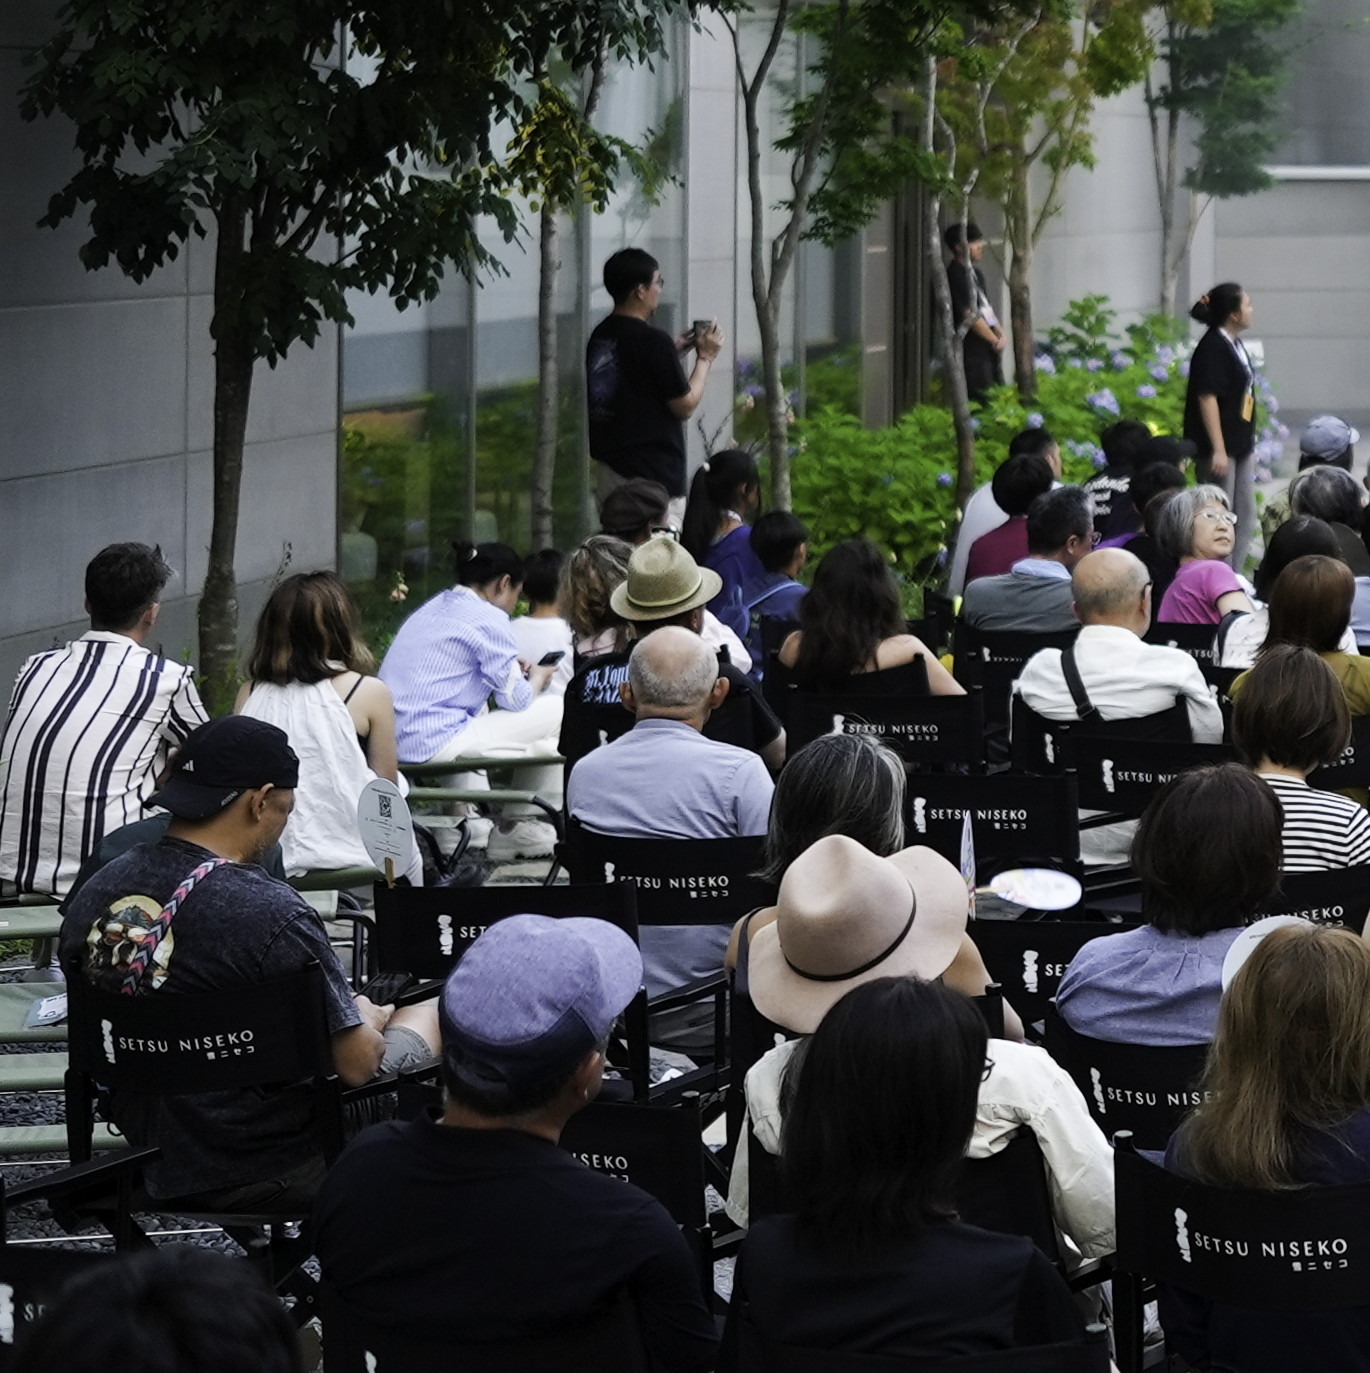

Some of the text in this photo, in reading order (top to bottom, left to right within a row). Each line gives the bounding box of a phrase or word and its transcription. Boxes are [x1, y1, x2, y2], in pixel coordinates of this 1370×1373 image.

[1187, 648, 1213, 659] TSU
[892, 723, 939, 735] NISEKO
[1117, 770, 1153, 784] SETSU
[930, 808, 1027, 821] SETSU NISEKO
[620, 875, 730, 890] TSU NISEKO
[459, 925, 487, 939] SET
[118, 1029, 255, 1054] SETSU NISEKO
[1107, 1086, 1221, 1107] SETSU NISE
[572, 1152, 629, 1170] SEKO
[1194, 1231, 1348, 1258] SETSU NISEKO
